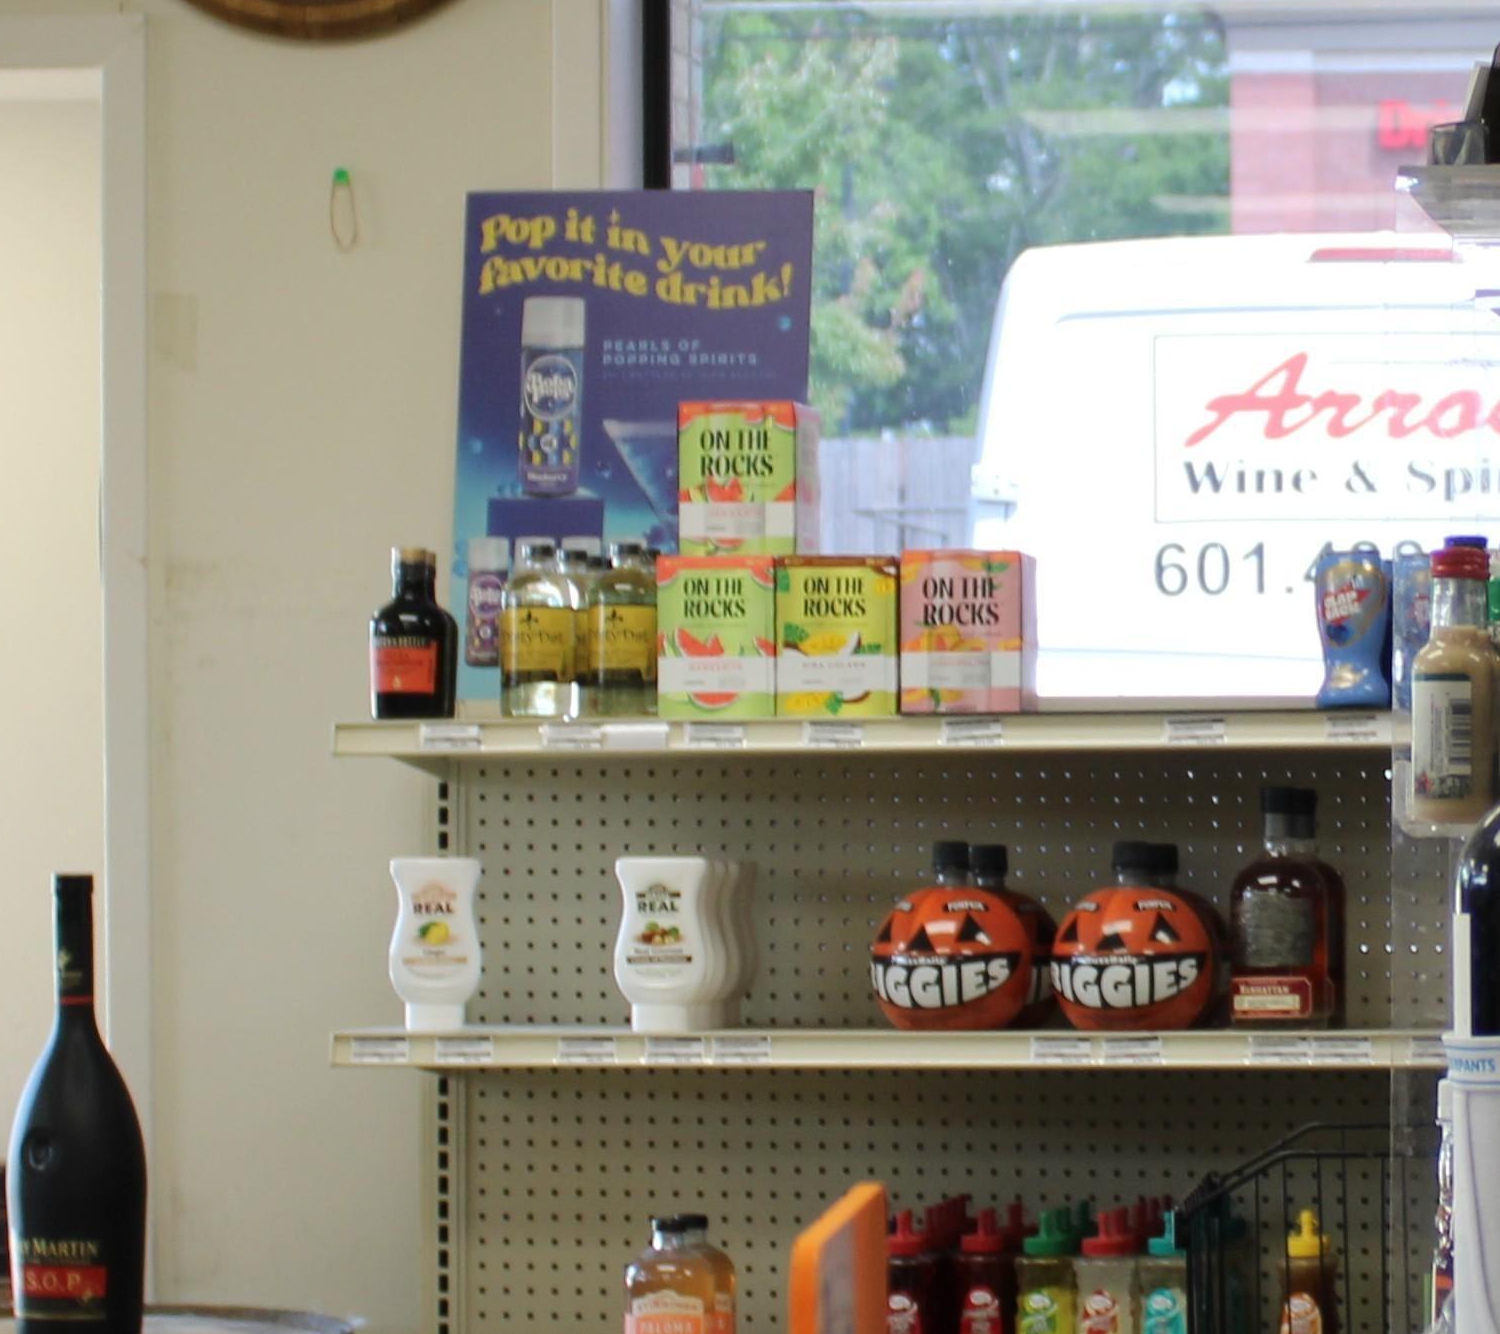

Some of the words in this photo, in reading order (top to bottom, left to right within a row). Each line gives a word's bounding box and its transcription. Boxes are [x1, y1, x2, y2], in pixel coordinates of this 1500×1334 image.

[480, 213, 557, 254] Pop
[565, 207, 596, 244] it
[607, 209, 650, 255] in
[656, 236, 766, 272] your
[478, 252, 648, 296] favorite
[655, 263, 794, 310] drink!
[603, 340, 671, 352] PEARLS
[603, 353, 680, 365] POPPING
[688, 353, 758, 365] SPIRITS
[699, 429, 731, 451] ON
[737, 429, 770, 451] THE
[699, 455, 774, 478] ROCKS
[1183, 460, 1318, 495] Wine
[1344, 459, 1379, 495] &
[683, 577, 710, 596] ON
[716, 577, 743, 596] THE
[802, 577, 830, 596] ON
[835, 577, 863, 596] THE
[922, 577, 954, 599] ON
[683, 598, 747, 618] ROCKS
[802, 598, 867, 618] ROCKS
[922, 603, 1000, 627] ROCKS
[412, 902, 455, 915] REAL
[637, 901, 680, 913] REAL
